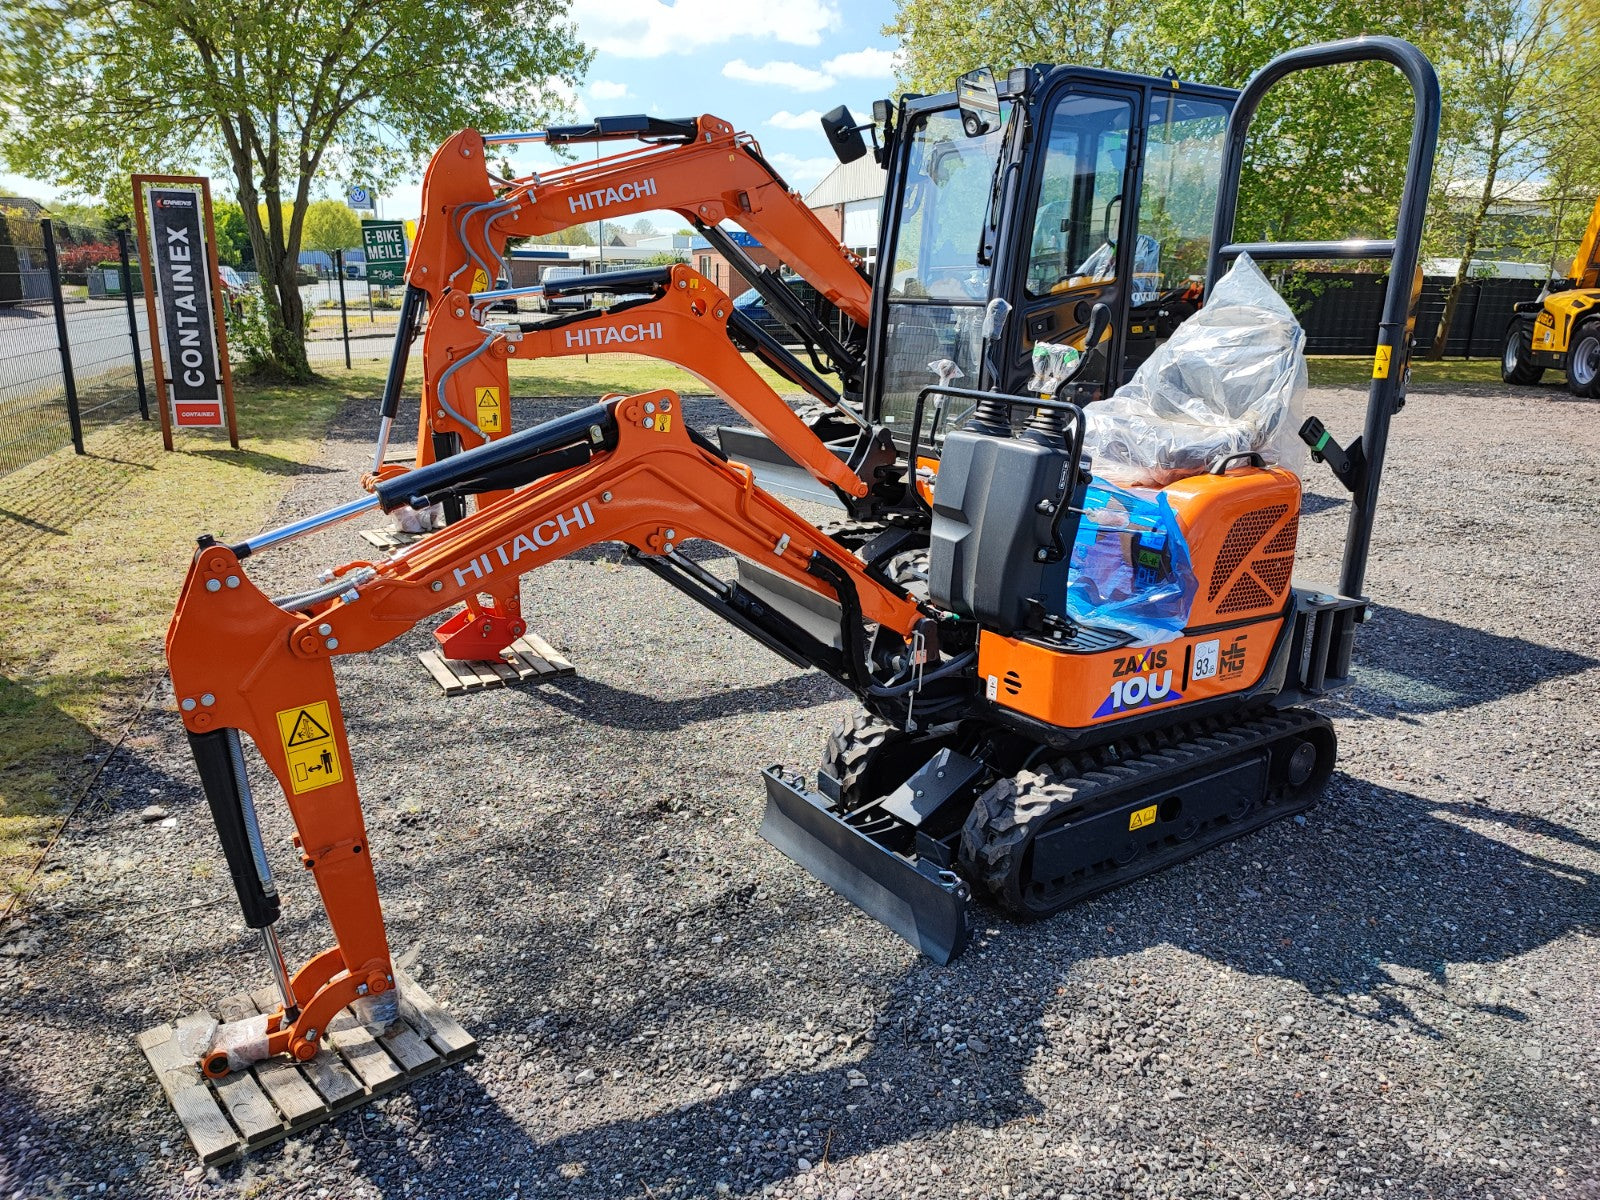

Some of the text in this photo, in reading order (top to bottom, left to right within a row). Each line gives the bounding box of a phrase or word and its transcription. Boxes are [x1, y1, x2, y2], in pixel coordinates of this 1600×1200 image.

[568, 177, 657, 214] HITACHI
[364, 229, 401, 244] E-BIKE
[367, 243, 404, 260] MEILE
[166, 226, 205, 387] CONTAINEX
[565, 322, 663, 348] HITACHI
[452, 501, 596, 588] HITACHI
[1112, 648, 1168, 678] ZAXIS
[1195, 657, 1209, 677] 93
[1110, 669, 1173, 710] 10U
